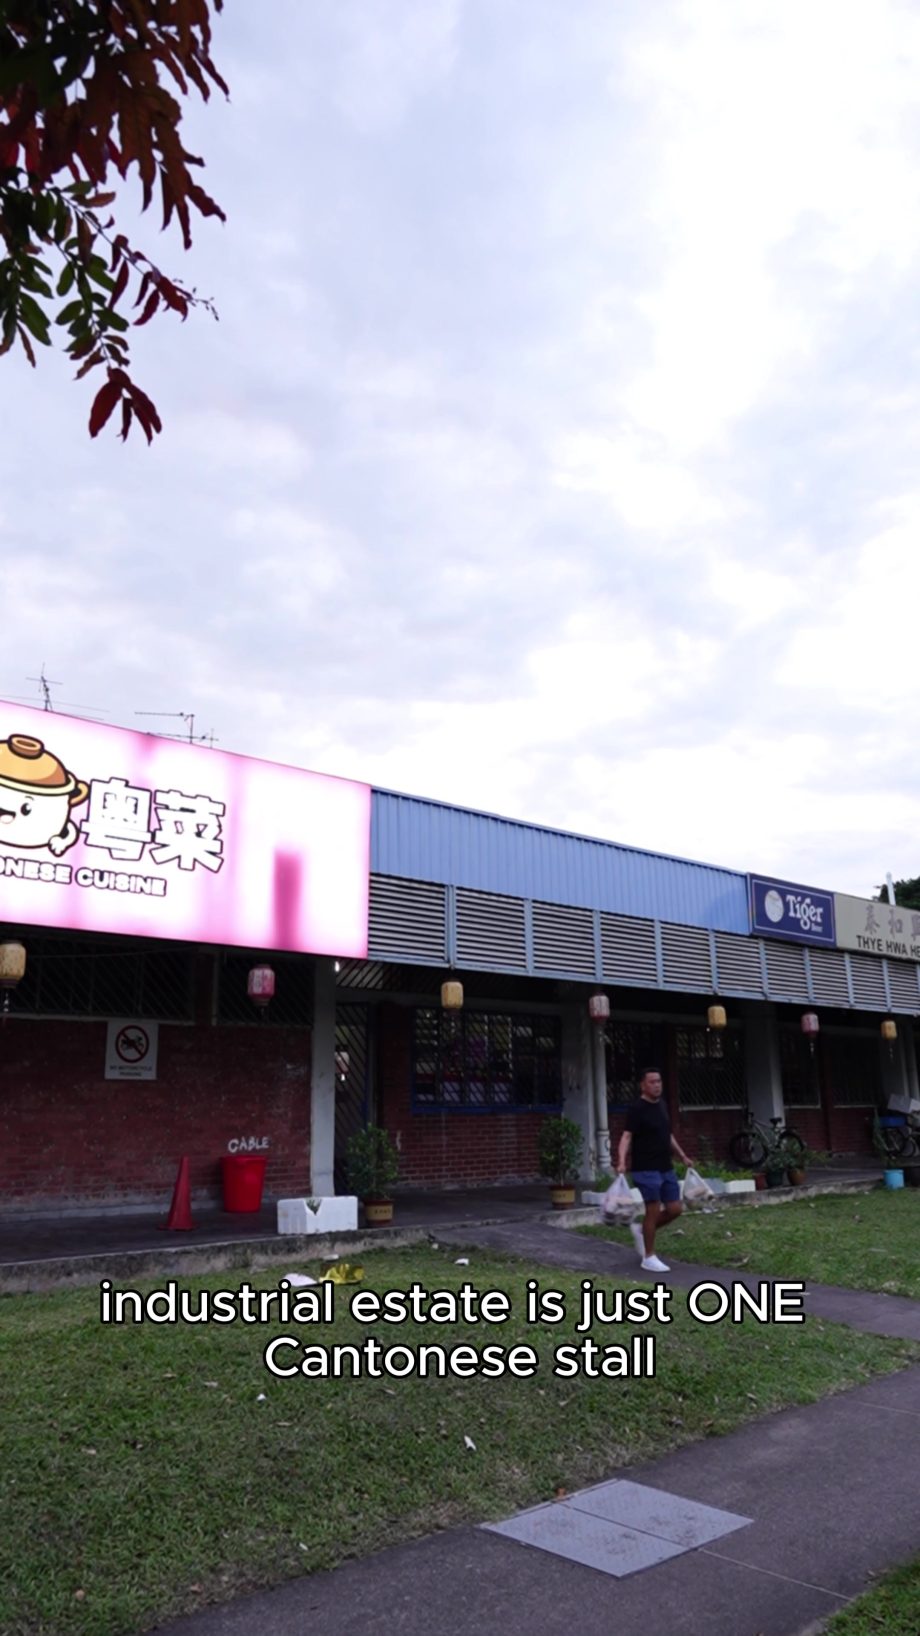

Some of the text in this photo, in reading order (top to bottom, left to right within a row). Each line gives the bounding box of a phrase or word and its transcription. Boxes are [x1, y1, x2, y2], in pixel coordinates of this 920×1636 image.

[75, 867, 167, 897] CUISINE
[786, 895, 824, 931] Tiger
[856, 935, 884, 952] THYE
[886, 940, 908, 955] HWA
[227, 1136, 270, 1153] CABLE
